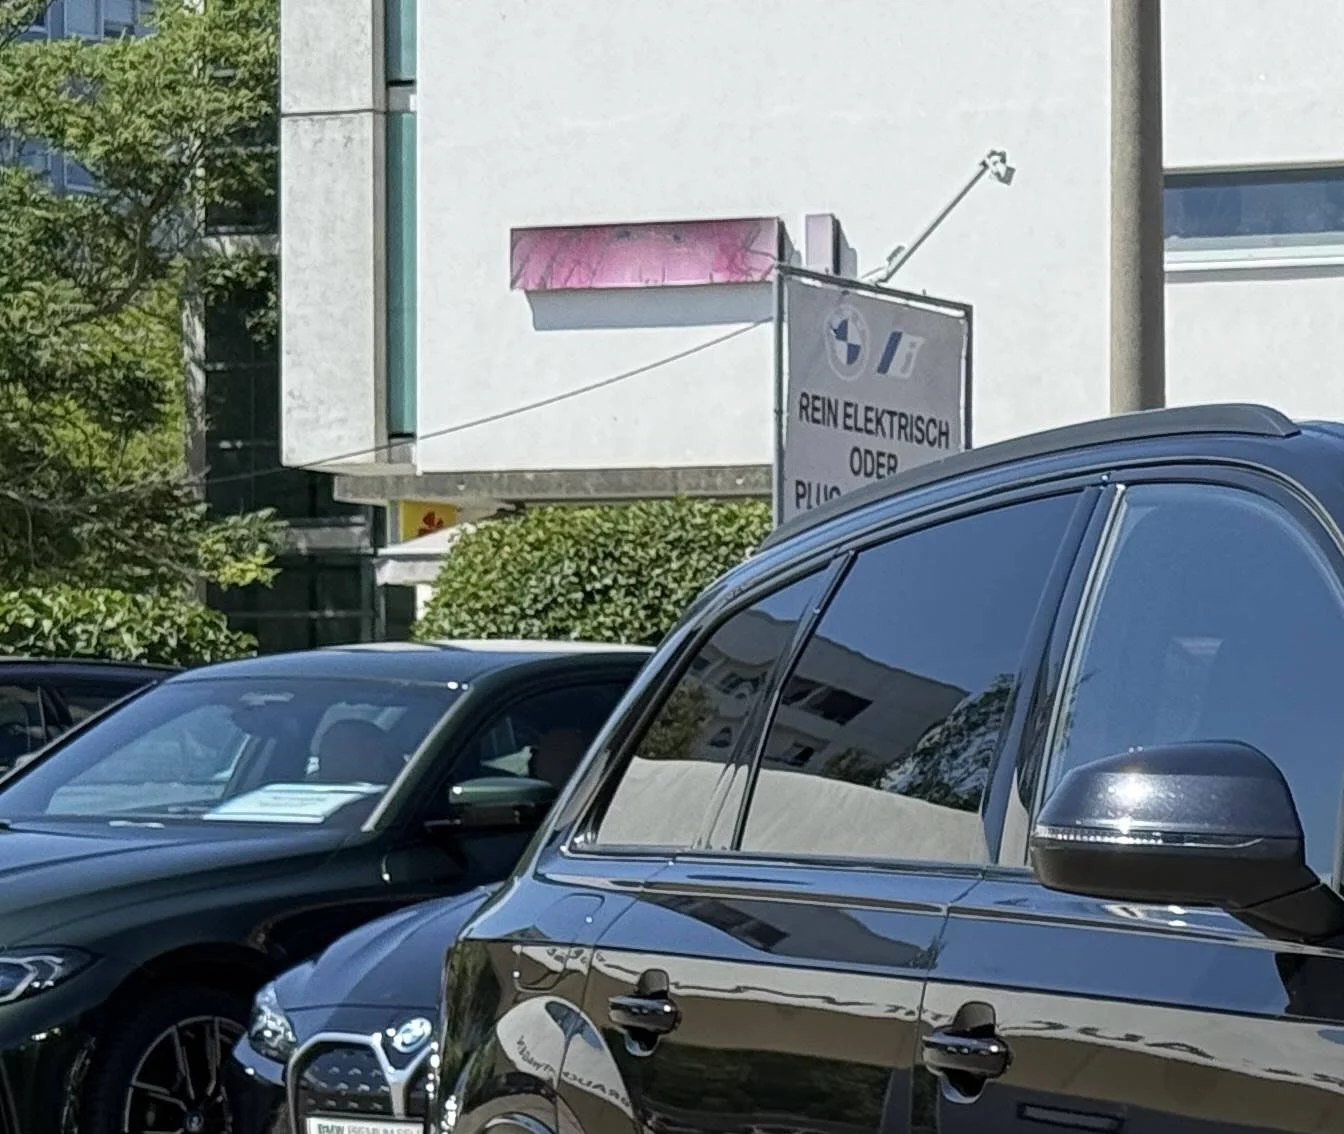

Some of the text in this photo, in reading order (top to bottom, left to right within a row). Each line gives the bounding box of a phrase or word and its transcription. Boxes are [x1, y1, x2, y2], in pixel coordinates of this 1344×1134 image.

[799, 391, 950, 449] REIN ELEKTRISCH
[850, 446, 898, 479] ODER
